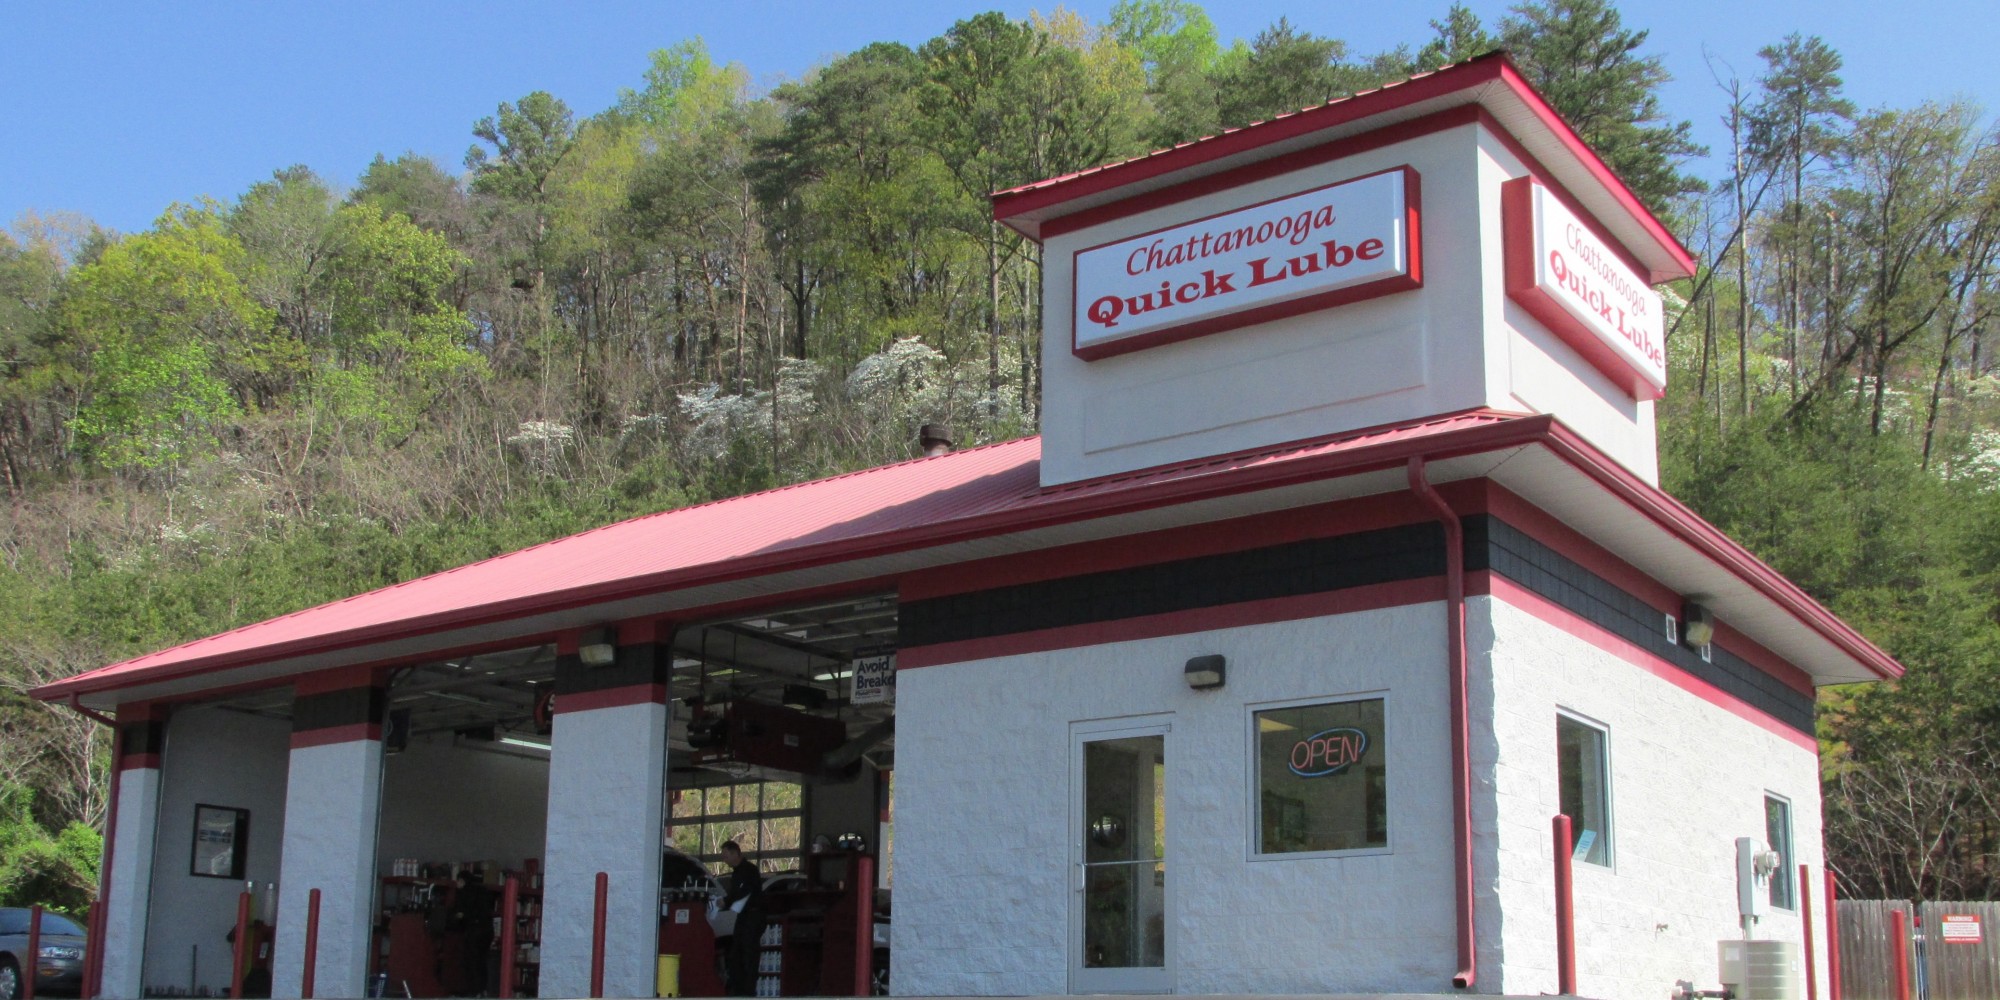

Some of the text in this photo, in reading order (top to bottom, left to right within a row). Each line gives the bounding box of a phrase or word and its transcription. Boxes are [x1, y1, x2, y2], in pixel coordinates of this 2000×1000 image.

[1126, 204, 1336, 276] Chattanooga
[1566, 223, 1646, 317] Chattanooga
[1087, 237, 1385, 328] Quick Lube
[1550, 249, 1663, 369] Quick Lube
[857, 655, 889, 674] Avoid
[1291, 735, 1360, 769] OPEN
